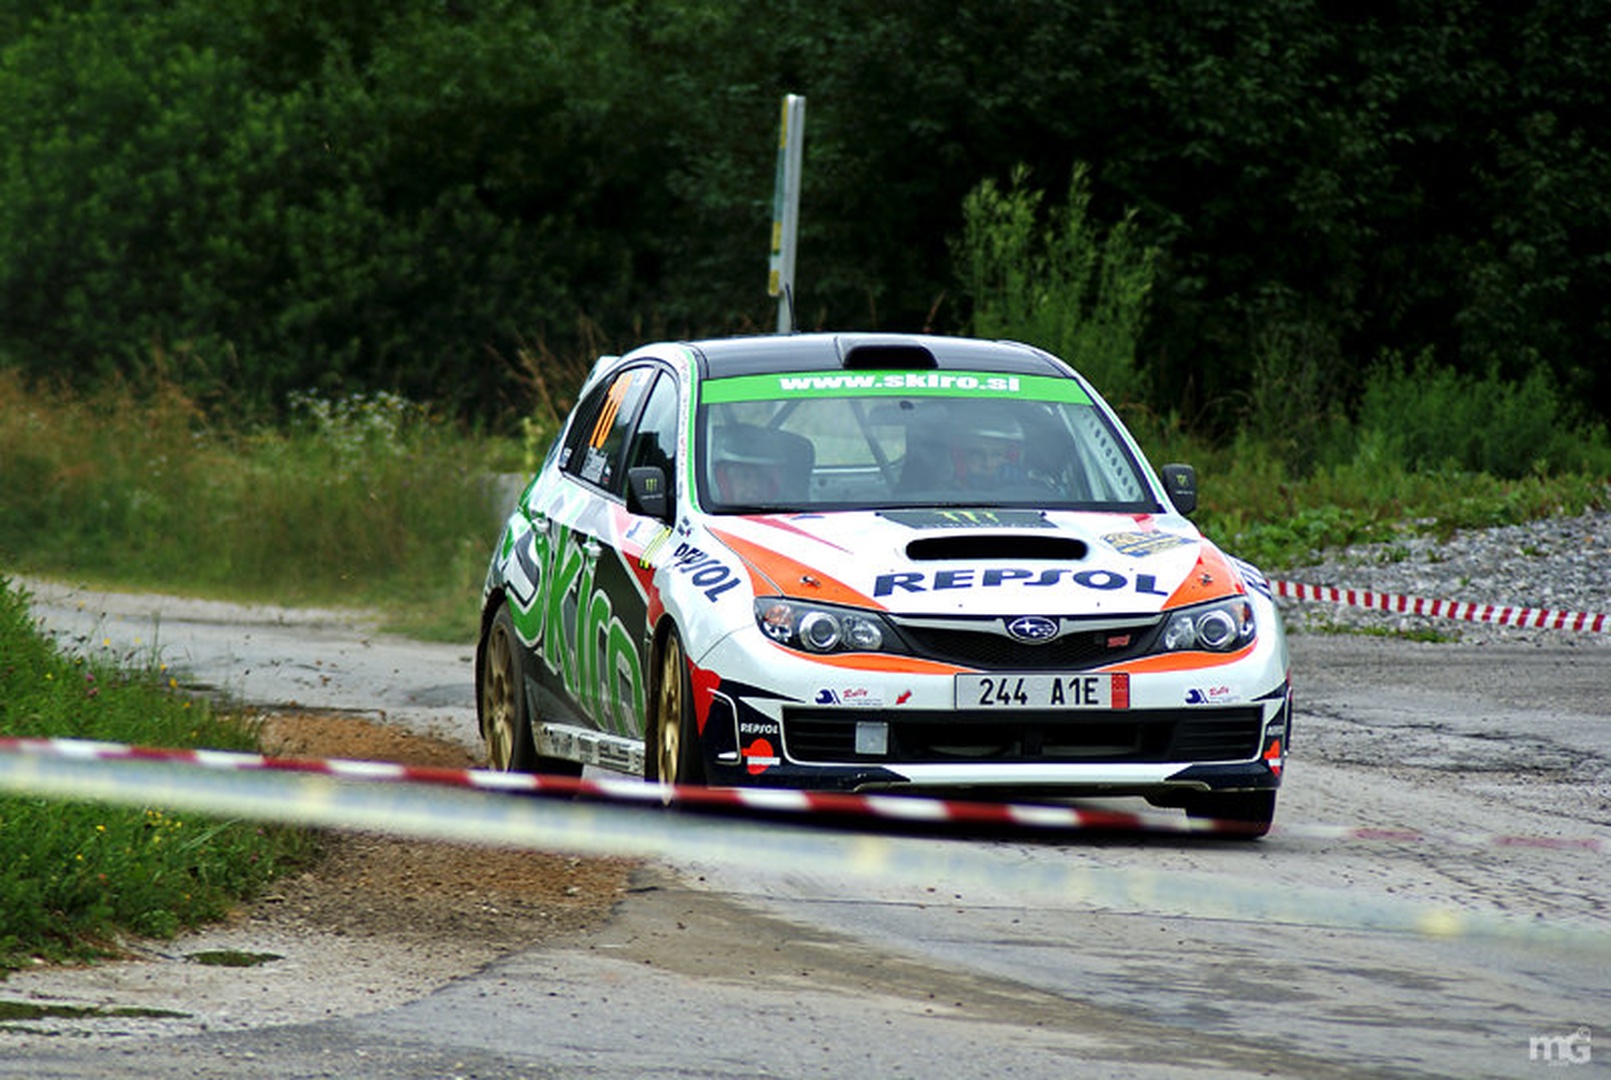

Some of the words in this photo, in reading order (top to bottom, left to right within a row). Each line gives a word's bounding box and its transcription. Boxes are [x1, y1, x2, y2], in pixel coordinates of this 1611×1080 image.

[780, 373, 1020, 391] www.skiro.si
[873, 568, 1169, 597] REPSOL
[979, 678, 1028, 705] 244
[1051, 678, 1099, 705] A1E
[741, 722, 778, 734] REPSOL
